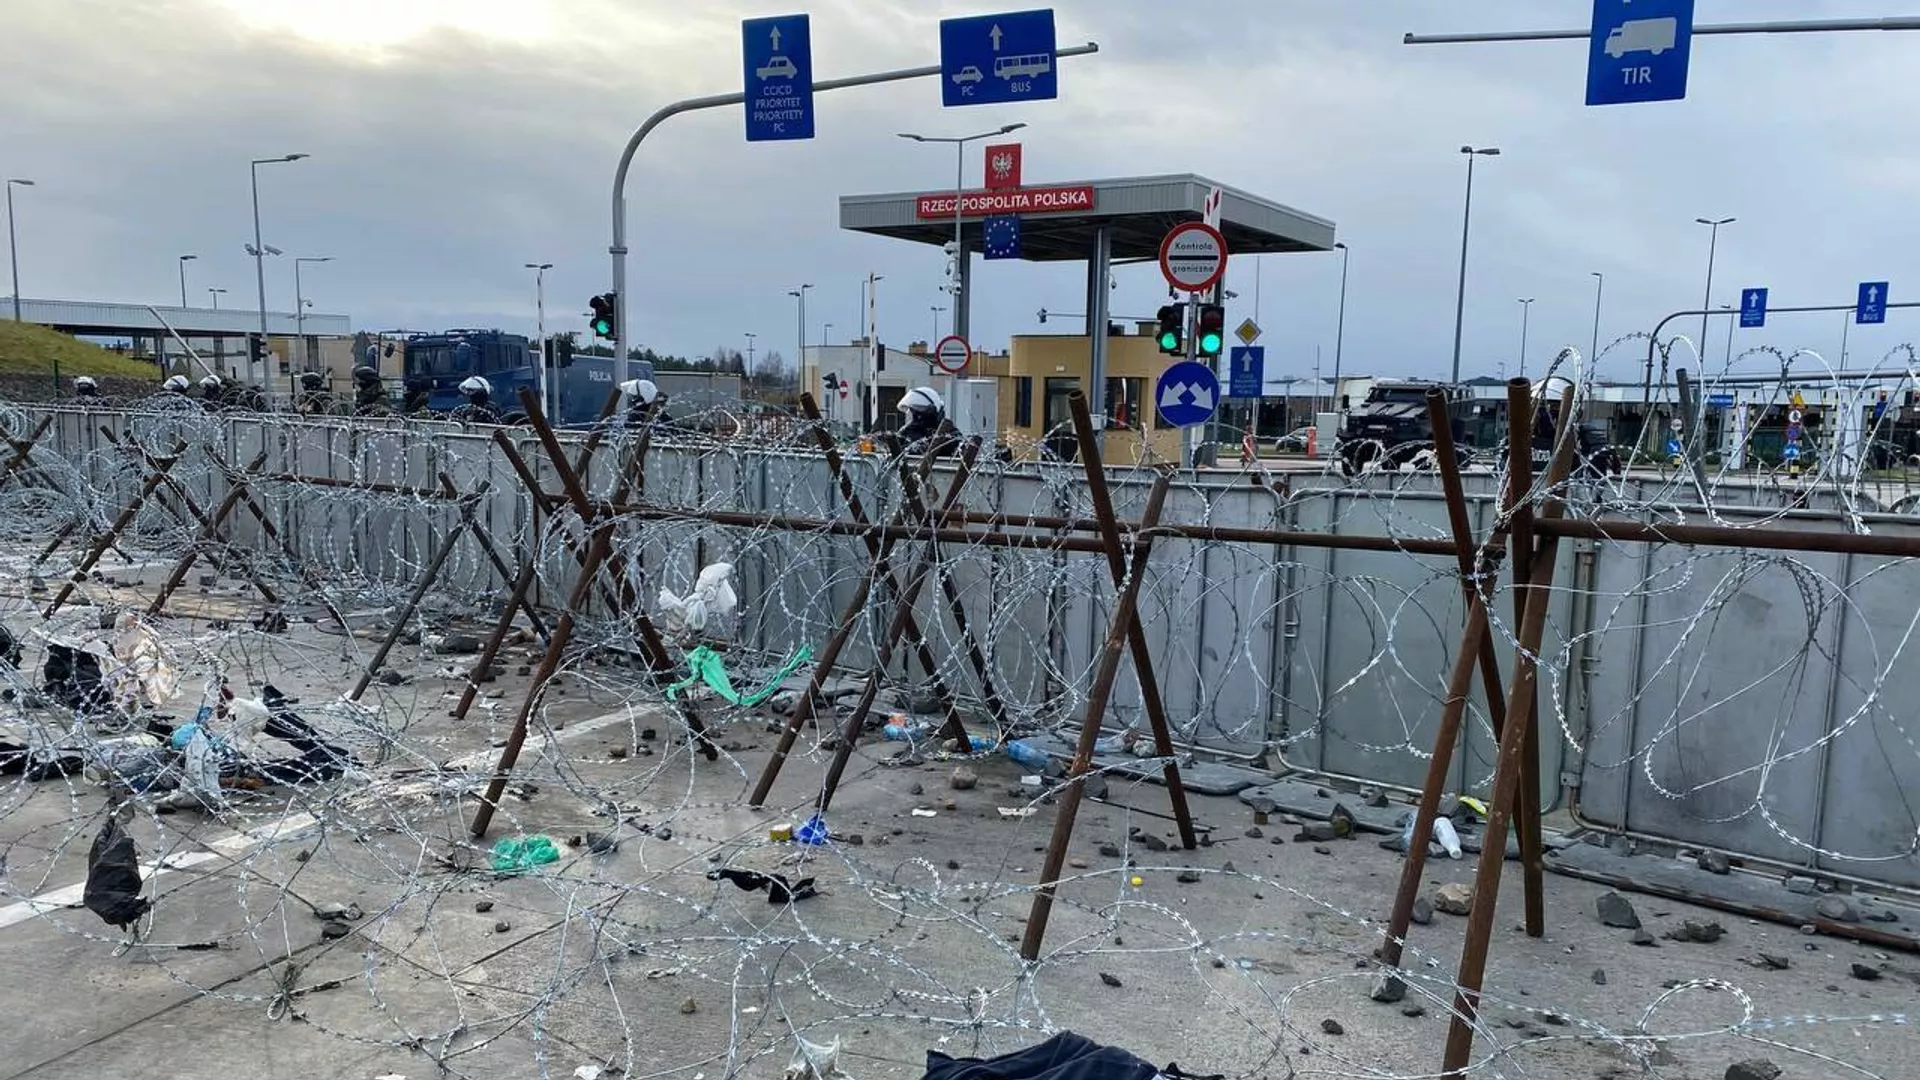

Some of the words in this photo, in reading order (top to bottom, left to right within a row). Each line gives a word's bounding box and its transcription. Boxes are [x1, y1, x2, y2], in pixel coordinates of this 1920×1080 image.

[1621, 66, 1652, 85] TIR
[961, 85, 975, 96] PC
[1010, 81, 1031, 93] BUS
[755, 97, 801, 109] PRIORYTET
[753, 109, 803, 121] PRIORYTETY
[773, 122, 786, 133] PC
[1034, 190, 1087, 207] POLSKA
[1175, 242, 1213, 251] Kontrola
